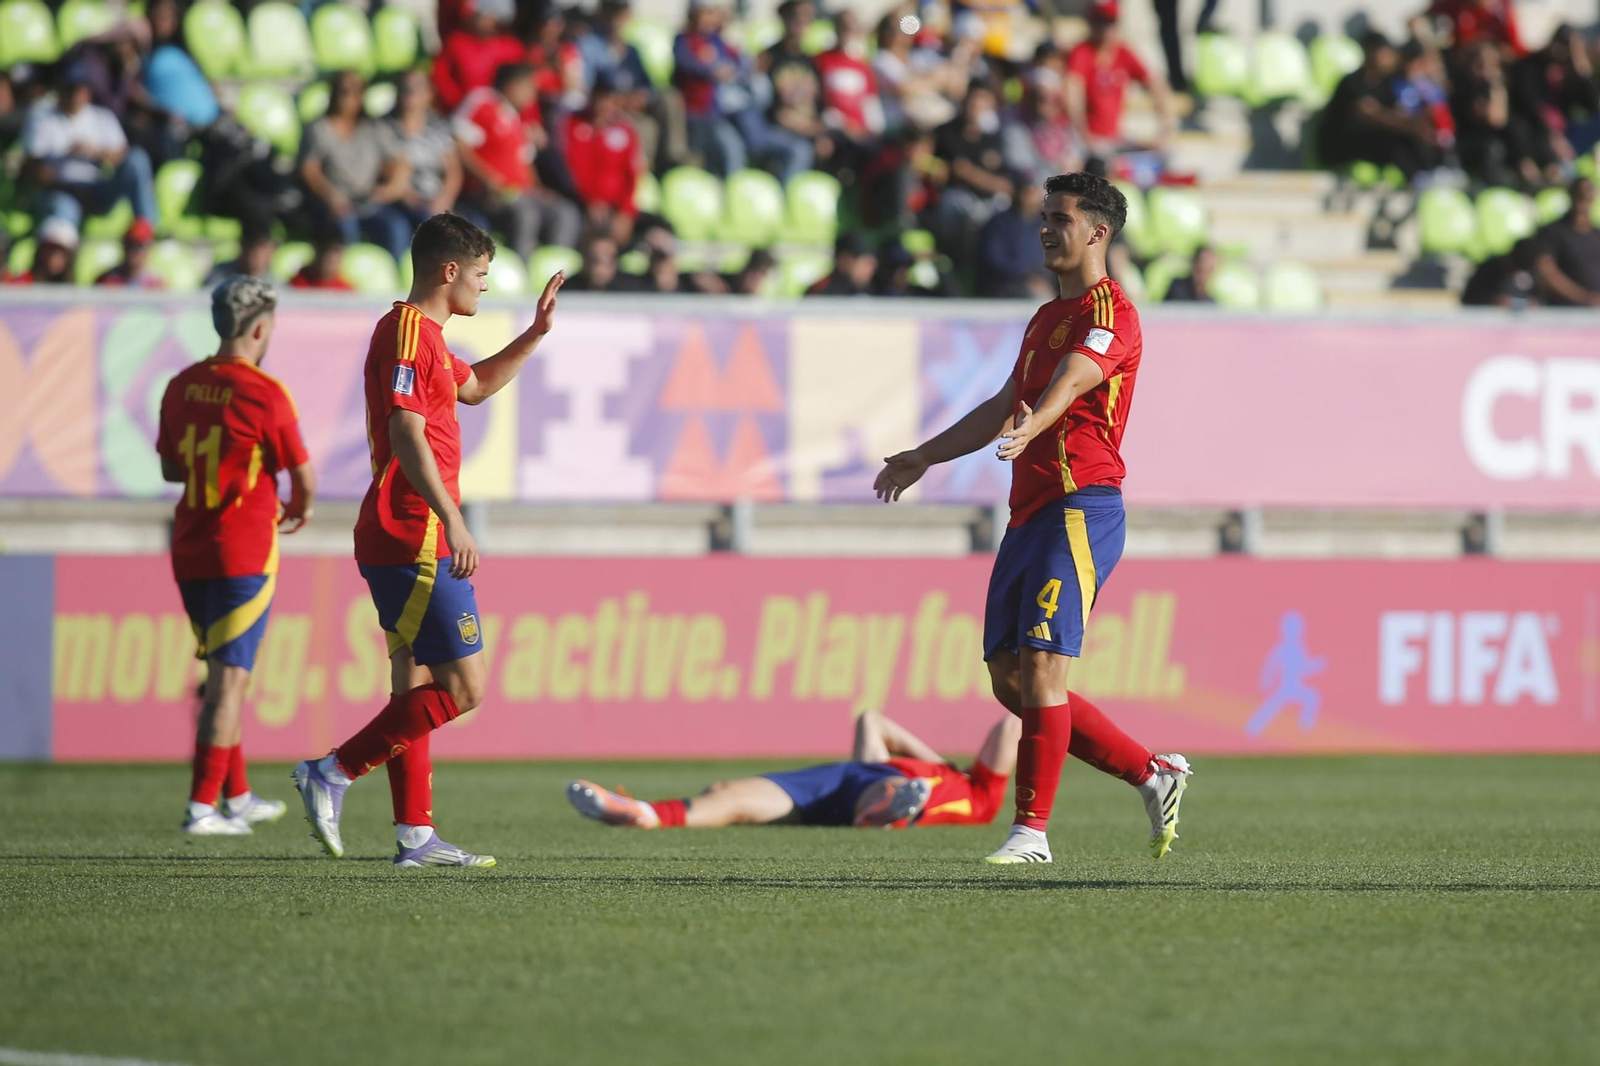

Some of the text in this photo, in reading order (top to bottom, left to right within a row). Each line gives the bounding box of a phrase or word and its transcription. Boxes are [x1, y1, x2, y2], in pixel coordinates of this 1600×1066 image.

[184, 383, 232, 405] MELLA
[179, 424, 222, 509] 11
[1036, 578, 1062, 619] 4
[55, 612, 326, 726] movg.
[503, 590, 739, 702] active.
[752, 593, 904, 719] Play
